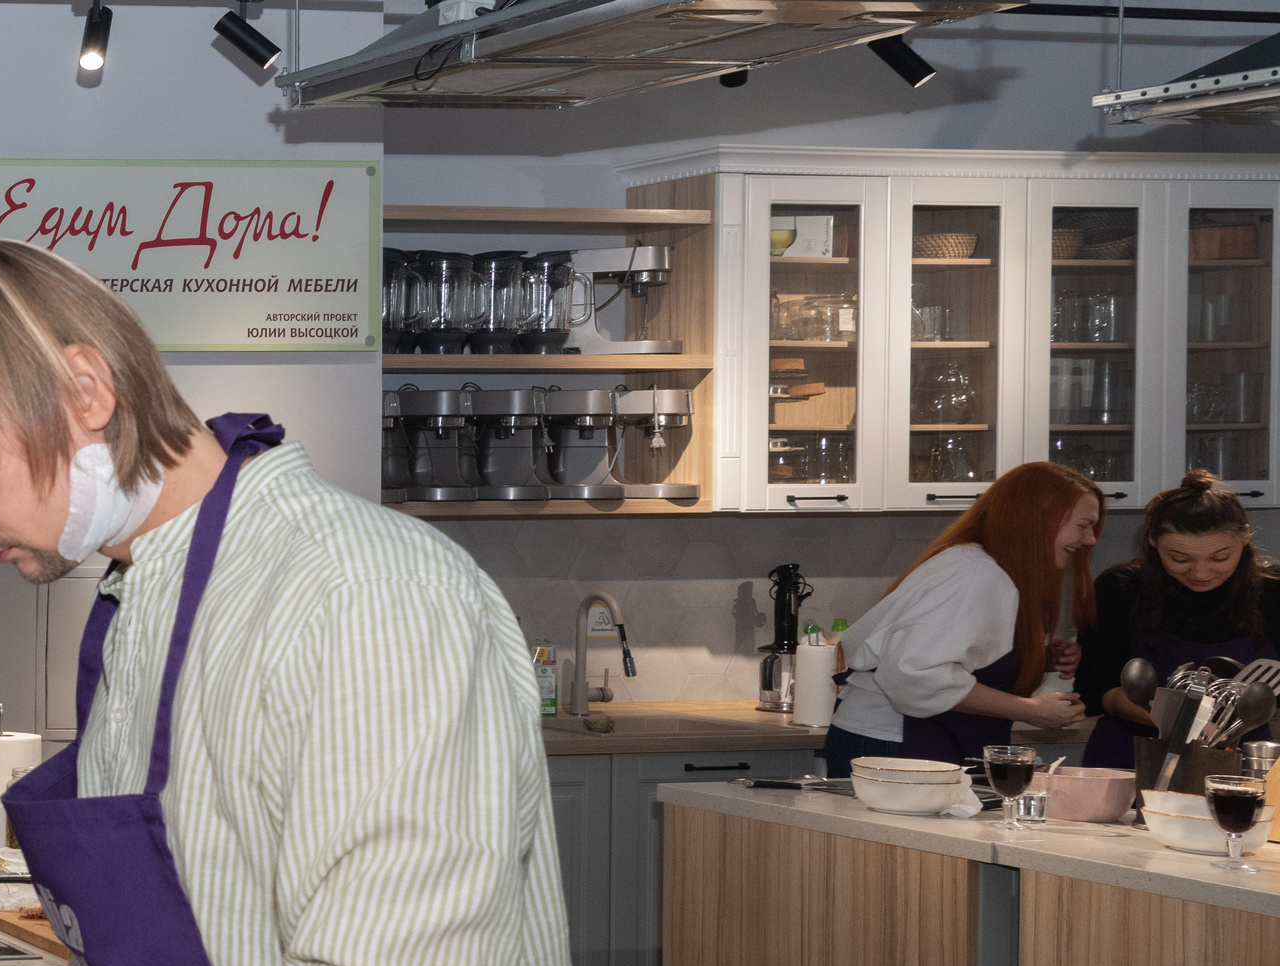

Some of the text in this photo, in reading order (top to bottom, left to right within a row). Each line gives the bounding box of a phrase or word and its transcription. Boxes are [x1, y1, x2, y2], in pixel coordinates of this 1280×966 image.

[131, 180, 334, 270] Дома!
[99, 275, 359, 293] ТЕРСКАЯ КУХОННОЙ МЕБЕЛИ
[266, 313, 359, 322] АВТОРСКИЙ ПРОЕКТ
[247, 327, 359, 340] ЮЛИИ ВЫСОЦКОЙ
